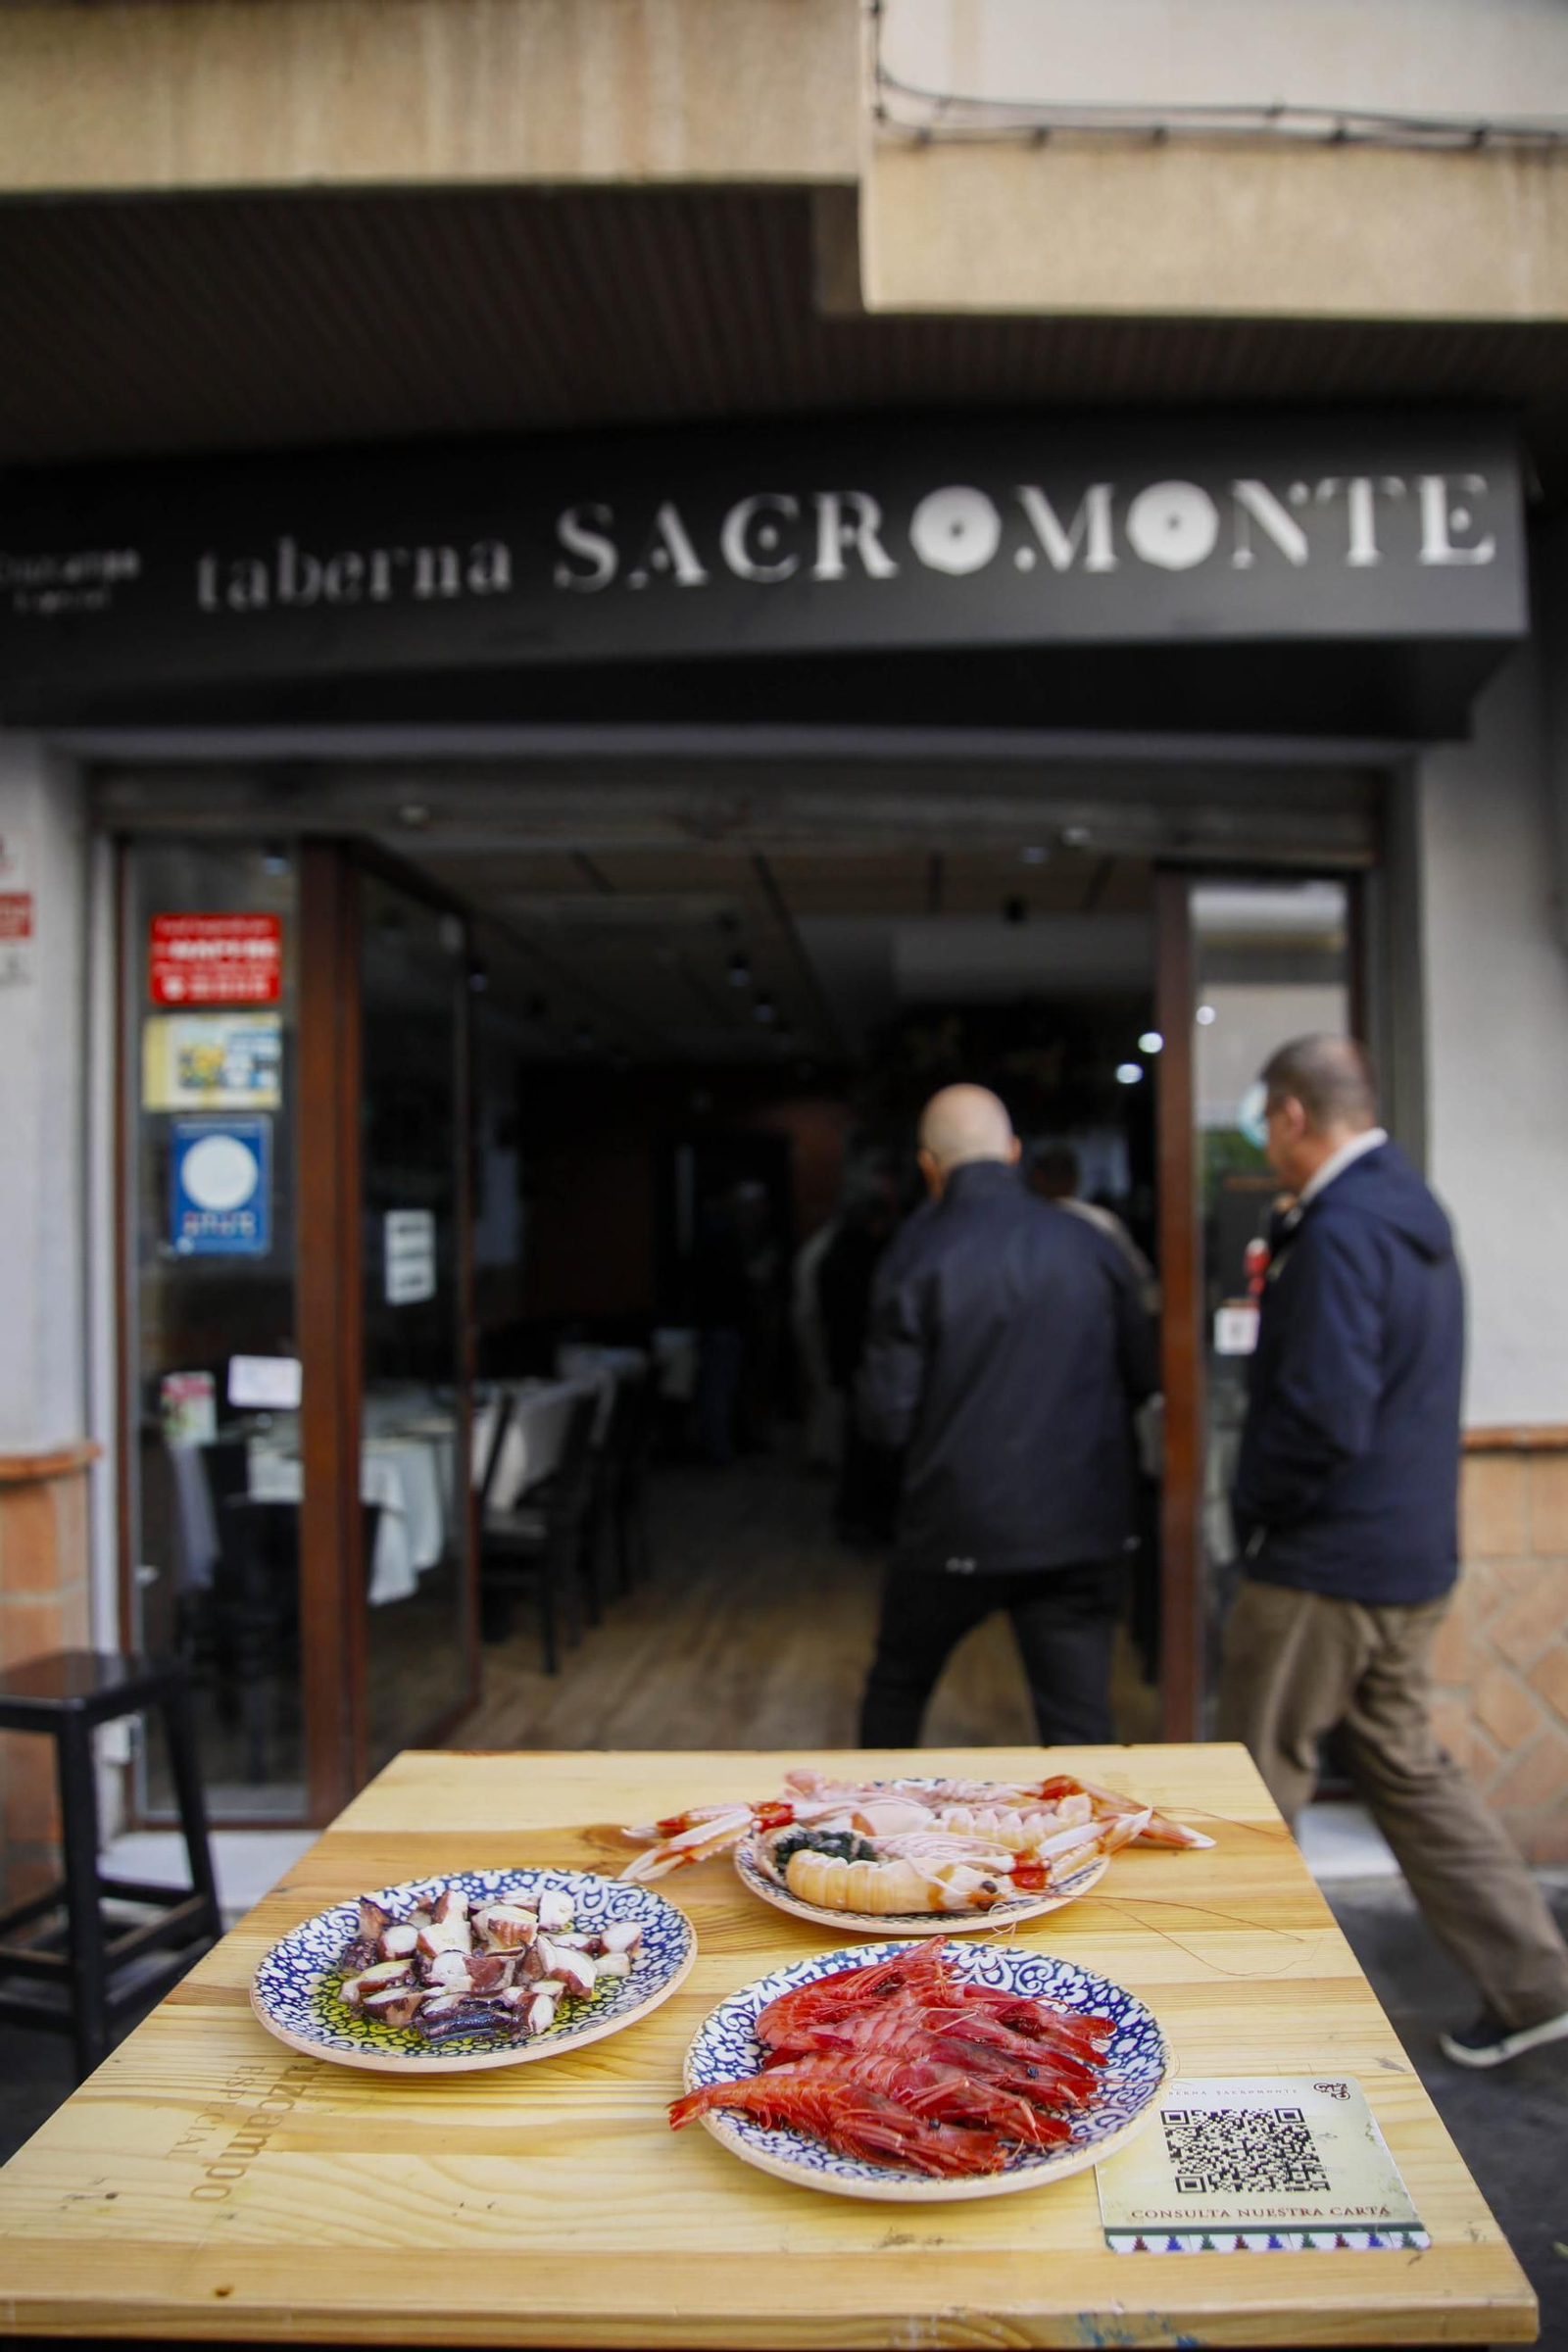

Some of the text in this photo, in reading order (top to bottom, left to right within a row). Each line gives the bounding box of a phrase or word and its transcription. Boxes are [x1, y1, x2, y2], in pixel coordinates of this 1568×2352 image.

[198, 474, 1495, 612] taberna SACROMONTE
[163, 2065, 266, 2161] ESPECIAL
[189, 2060, 325, 2203] uzcampo
[1131, 2204, 1391, 2219] CONSULTA NUESTRA CARTA
